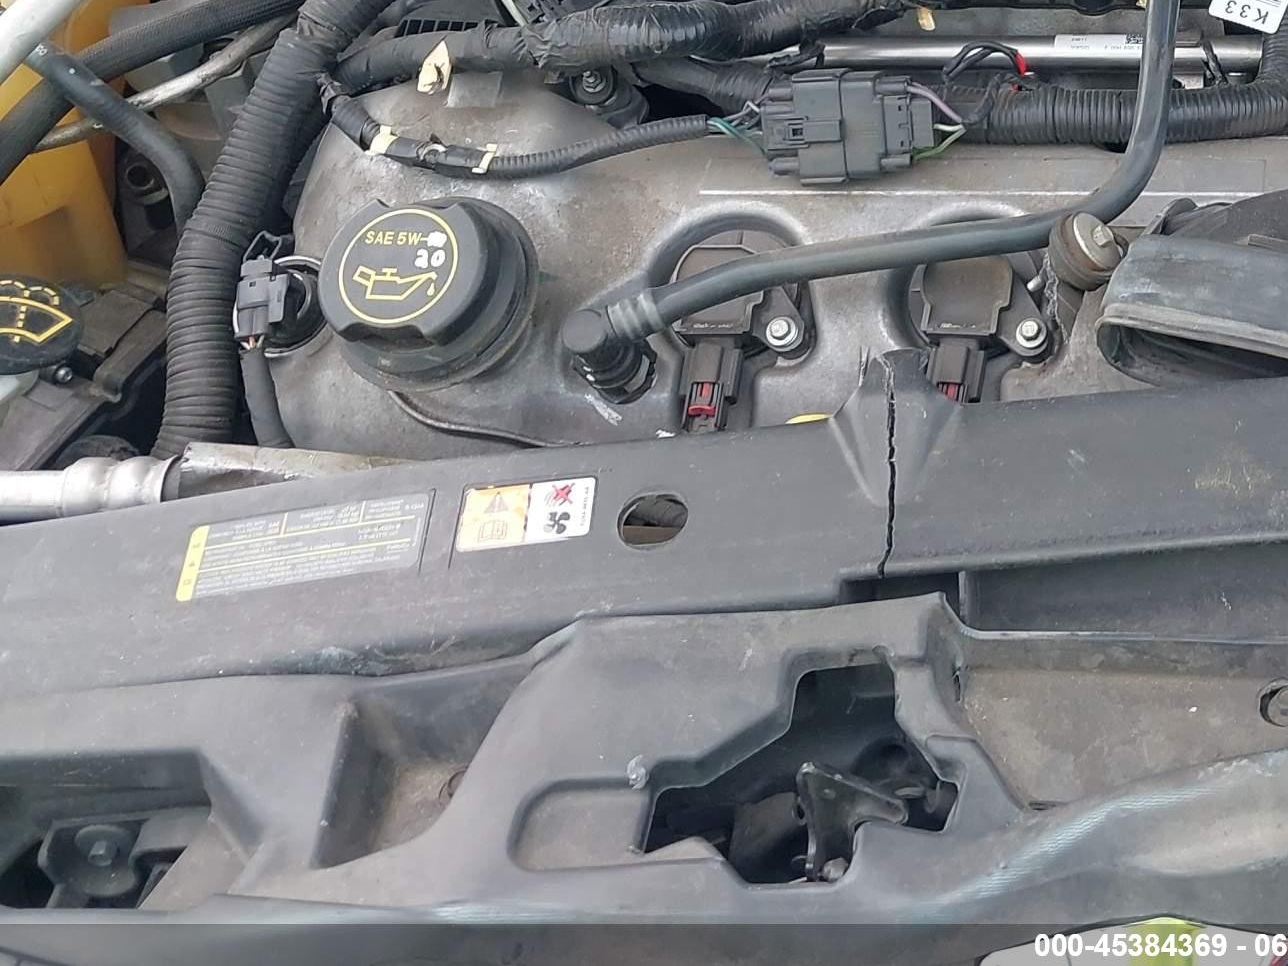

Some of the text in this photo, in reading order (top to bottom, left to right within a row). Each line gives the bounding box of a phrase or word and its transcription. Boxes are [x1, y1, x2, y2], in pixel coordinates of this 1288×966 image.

[1225, 0, 1269, 24] K33
[365, 230, 447, 247] SAE 5W-
